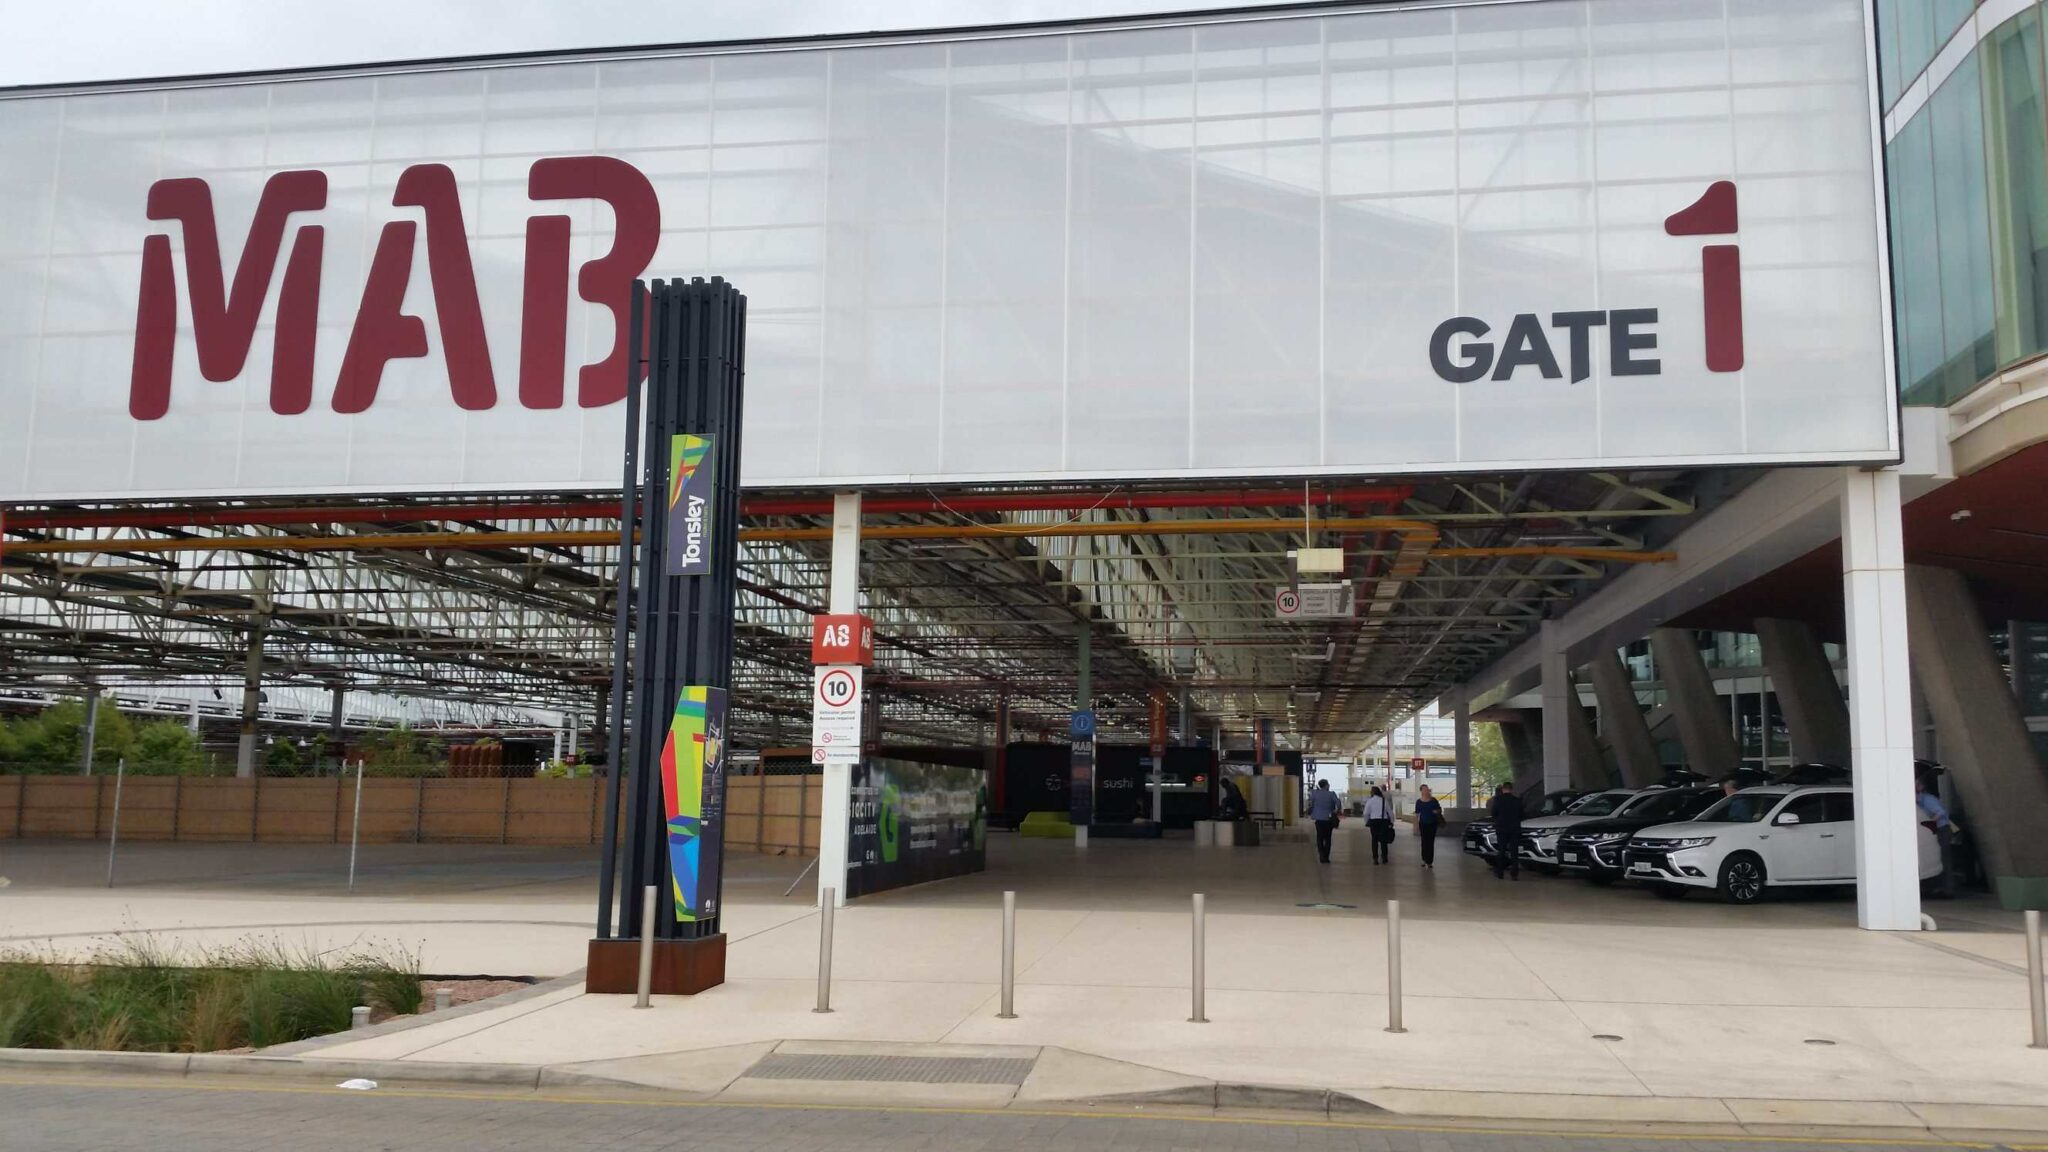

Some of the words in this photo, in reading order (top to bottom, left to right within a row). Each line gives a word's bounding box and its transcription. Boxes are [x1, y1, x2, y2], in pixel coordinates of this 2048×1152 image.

[129, 156, 661, 420] MAB
[1429, 308, 1661, 384] GATE
[1664, 180, 1745, 373] 1
[682, 494, 706, 568] Tonsley
[1282, 596, 1295, 608] 10
[822, 624, 850, 647] A8
[828, 681, 848, 697] 10
[1103, 777, 1134, 789] sushi
